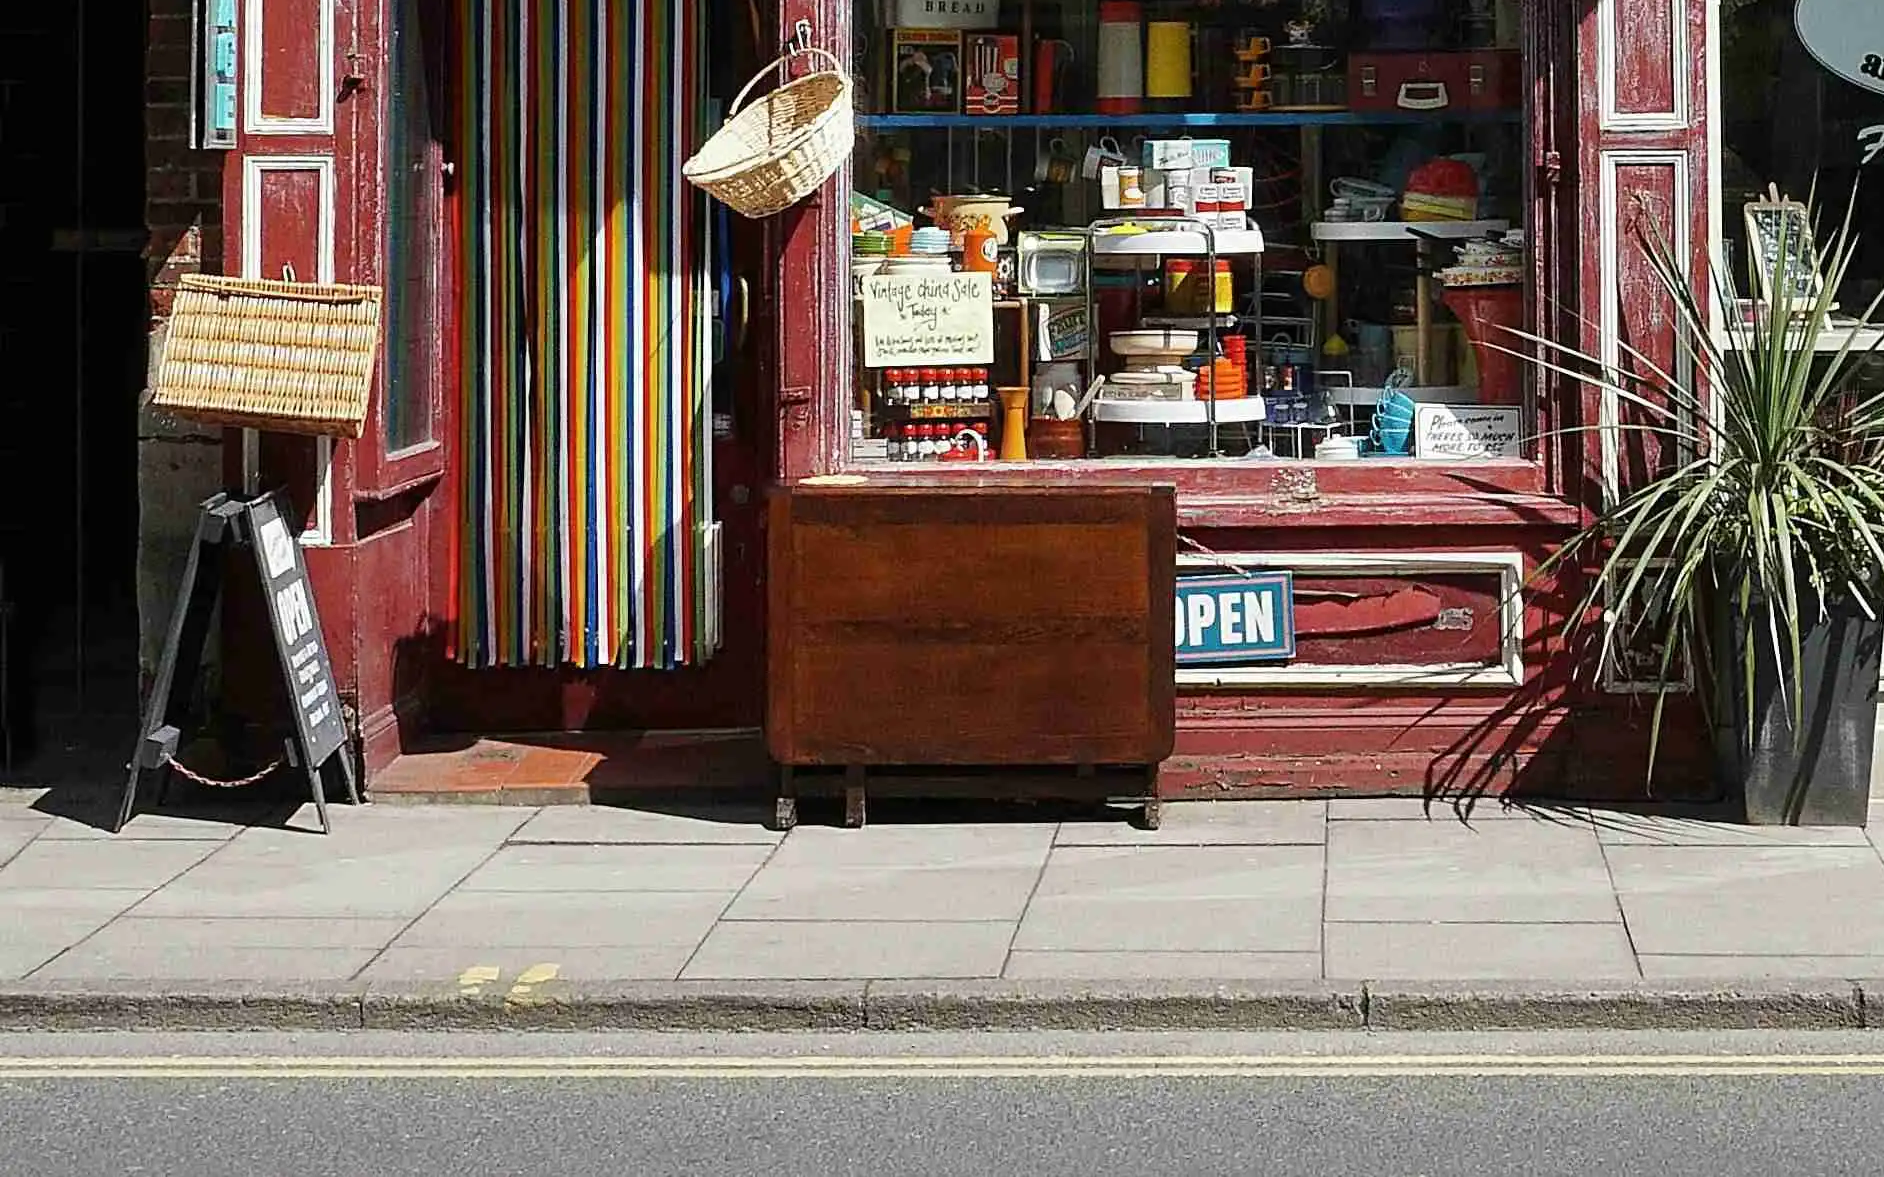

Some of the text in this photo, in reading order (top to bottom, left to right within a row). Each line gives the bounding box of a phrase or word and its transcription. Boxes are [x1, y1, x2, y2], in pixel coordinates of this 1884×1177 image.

[925, 0, 985, 14] BREAD
[870, 279, 912, 312] Vintage
[952, 278, 980, 303] Sale
